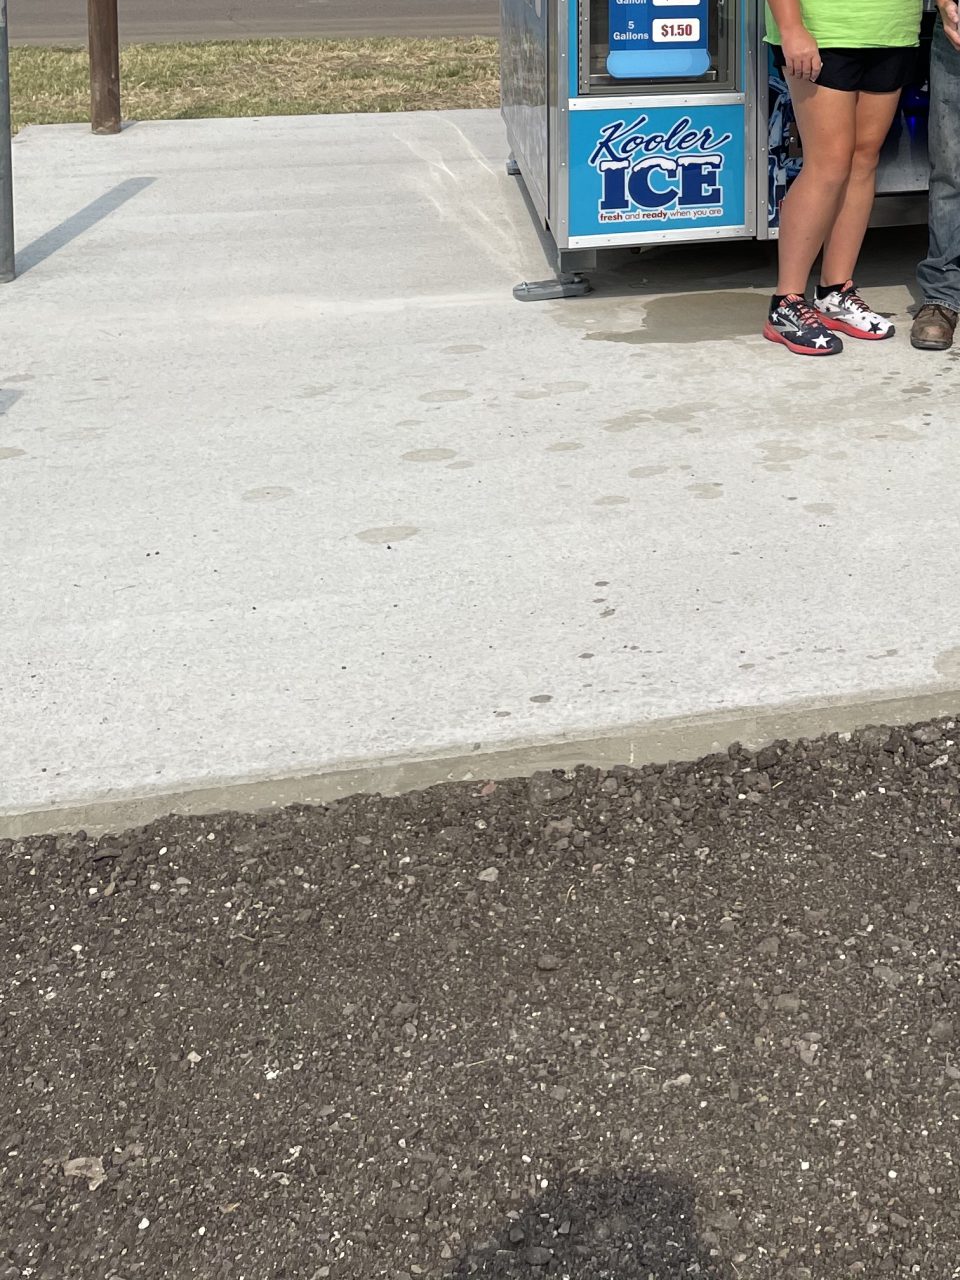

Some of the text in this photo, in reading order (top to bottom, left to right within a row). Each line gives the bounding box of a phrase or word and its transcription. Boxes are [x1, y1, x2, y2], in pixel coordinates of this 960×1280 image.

[627, 20, 635, 30] 5
[660, 24, 693, 38] $1.50
[613, 31, 649, 41] Gallons
[590, 116, 731, 164] Kooler
[600, 154, 723, 211] ICE
[600, 213, 623, 222] fresh
[624, 212, 641, 220] and
[642, 210, 667, 221] ready
[669, 209, 691, 217] when
[692, 209, 707, 218] you
